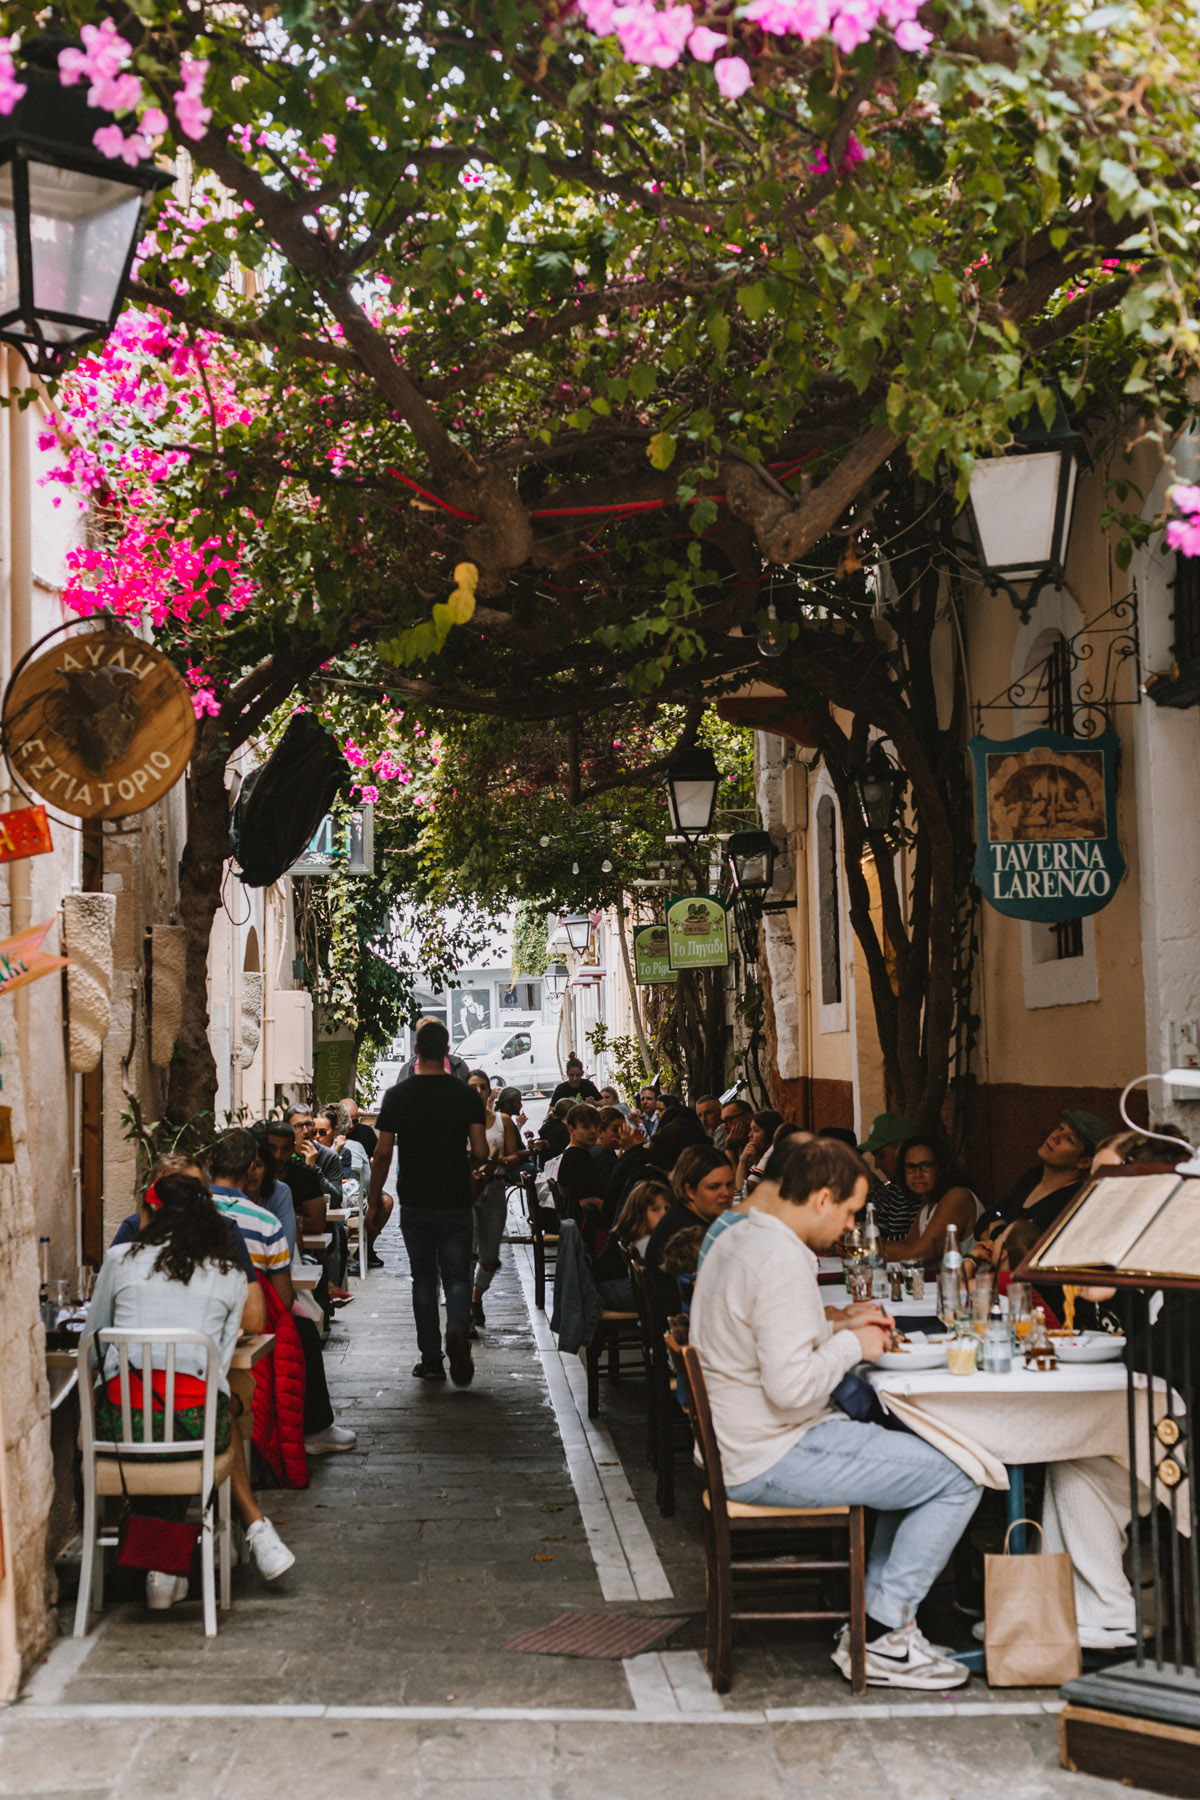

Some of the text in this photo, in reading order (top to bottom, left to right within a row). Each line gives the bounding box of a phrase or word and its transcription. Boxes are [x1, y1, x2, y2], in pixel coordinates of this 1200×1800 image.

[18, 739, 172, 806] ΕΣΤΙΑΤΟΡΙΟ
[990, 842, 1106, 871] TAVERNA
[992, 869, 1111, 899] LARENZO
[687, 938, 724, 958] Πηγάδι
